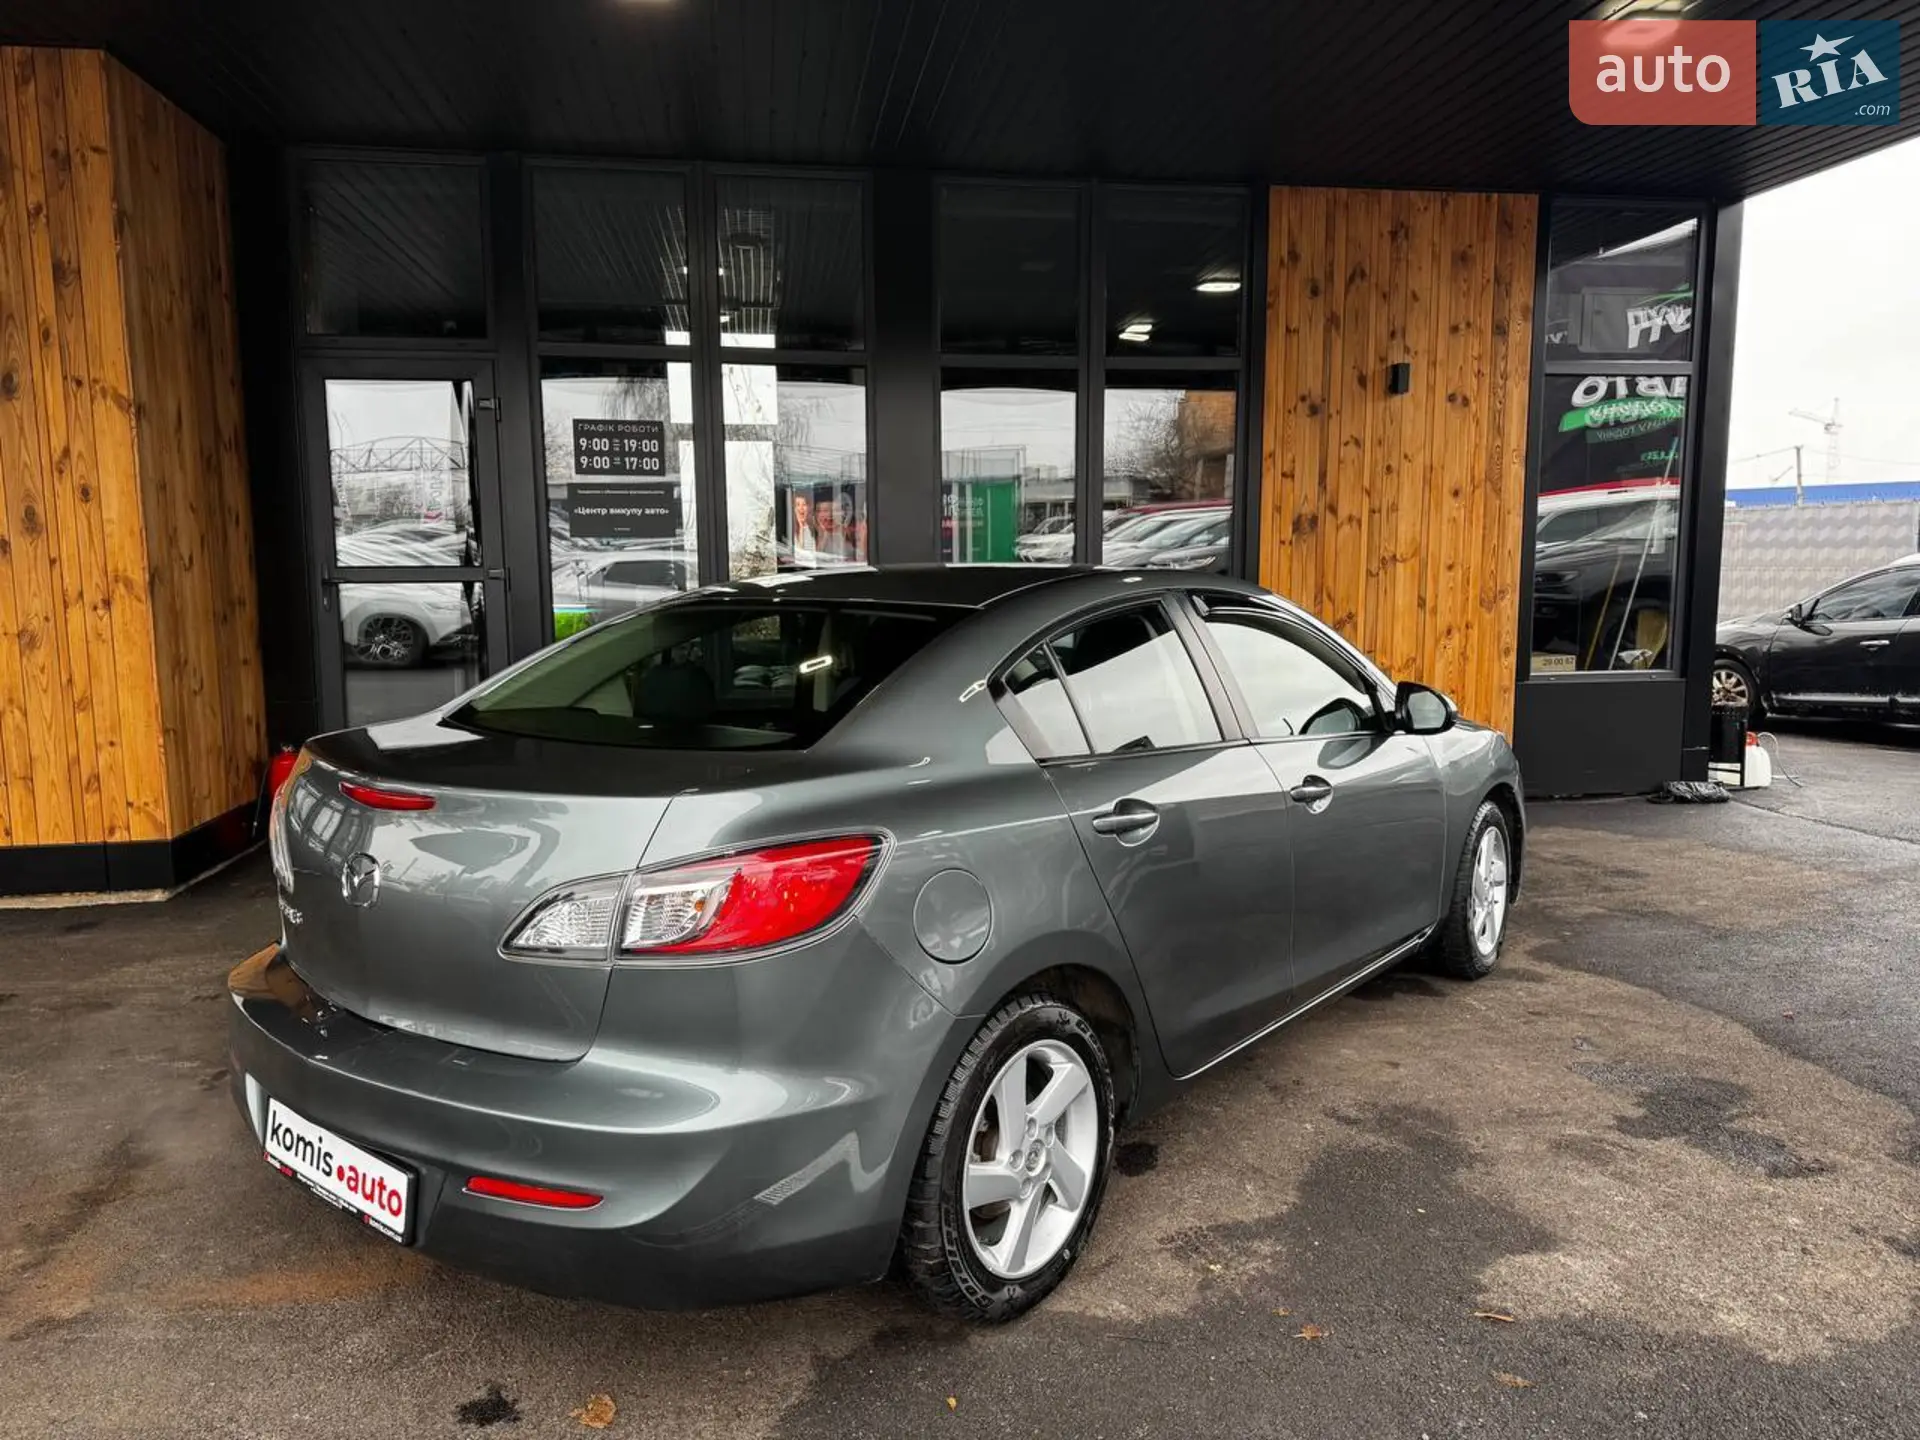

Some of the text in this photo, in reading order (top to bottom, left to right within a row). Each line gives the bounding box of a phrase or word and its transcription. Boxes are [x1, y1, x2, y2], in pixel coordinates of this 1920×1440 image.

[578, 424, 659, 433] ГРАФІК РОБОТИ
[579, 437, 610, 451] 9:00
[623, 439, 659, 452] 19:00
[580, 456, 610, 469] 9:00
[624, 457, 660, 471] 17:00
[609, 507, 643, 517] викупу
